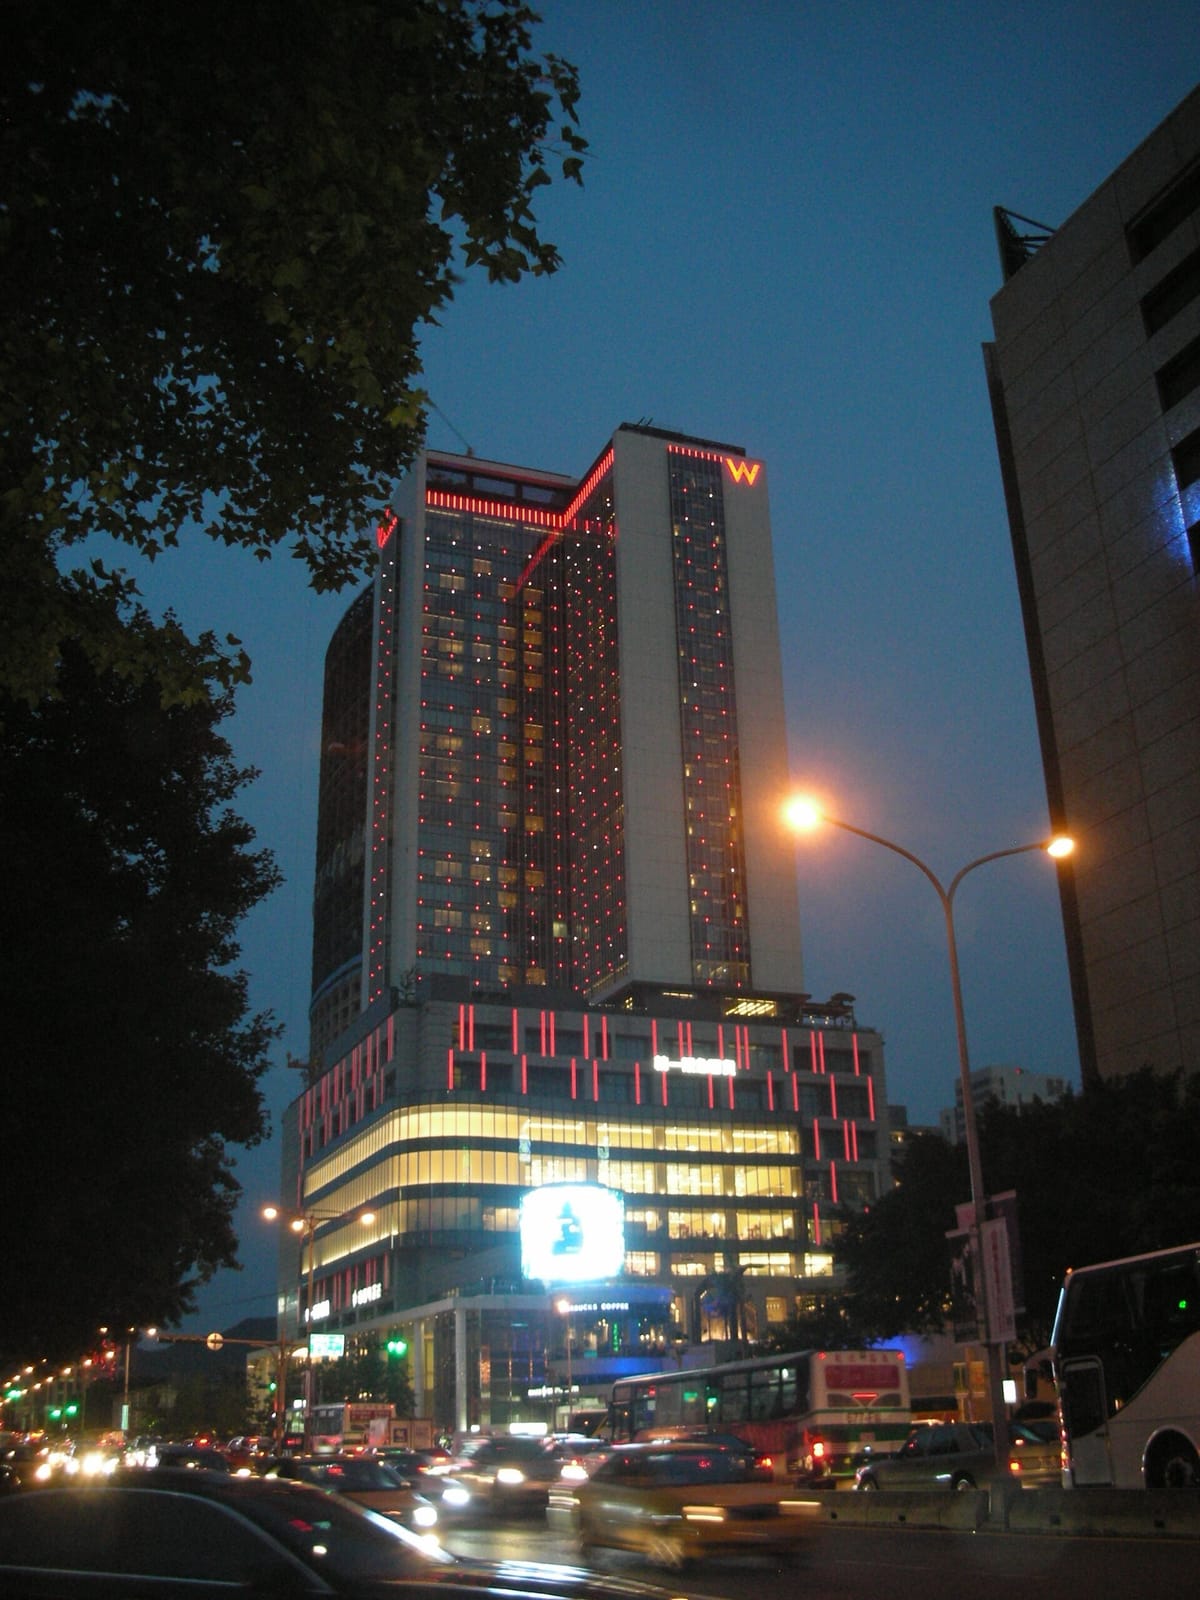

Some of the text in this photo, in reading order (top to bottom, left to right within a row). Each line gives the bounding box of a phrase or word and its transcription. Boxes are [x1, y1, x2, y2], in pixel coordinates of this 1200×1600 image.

[725, 457, 761, 486] W
[559, 1302, 629, 1312] RBUCKS COFFEE
